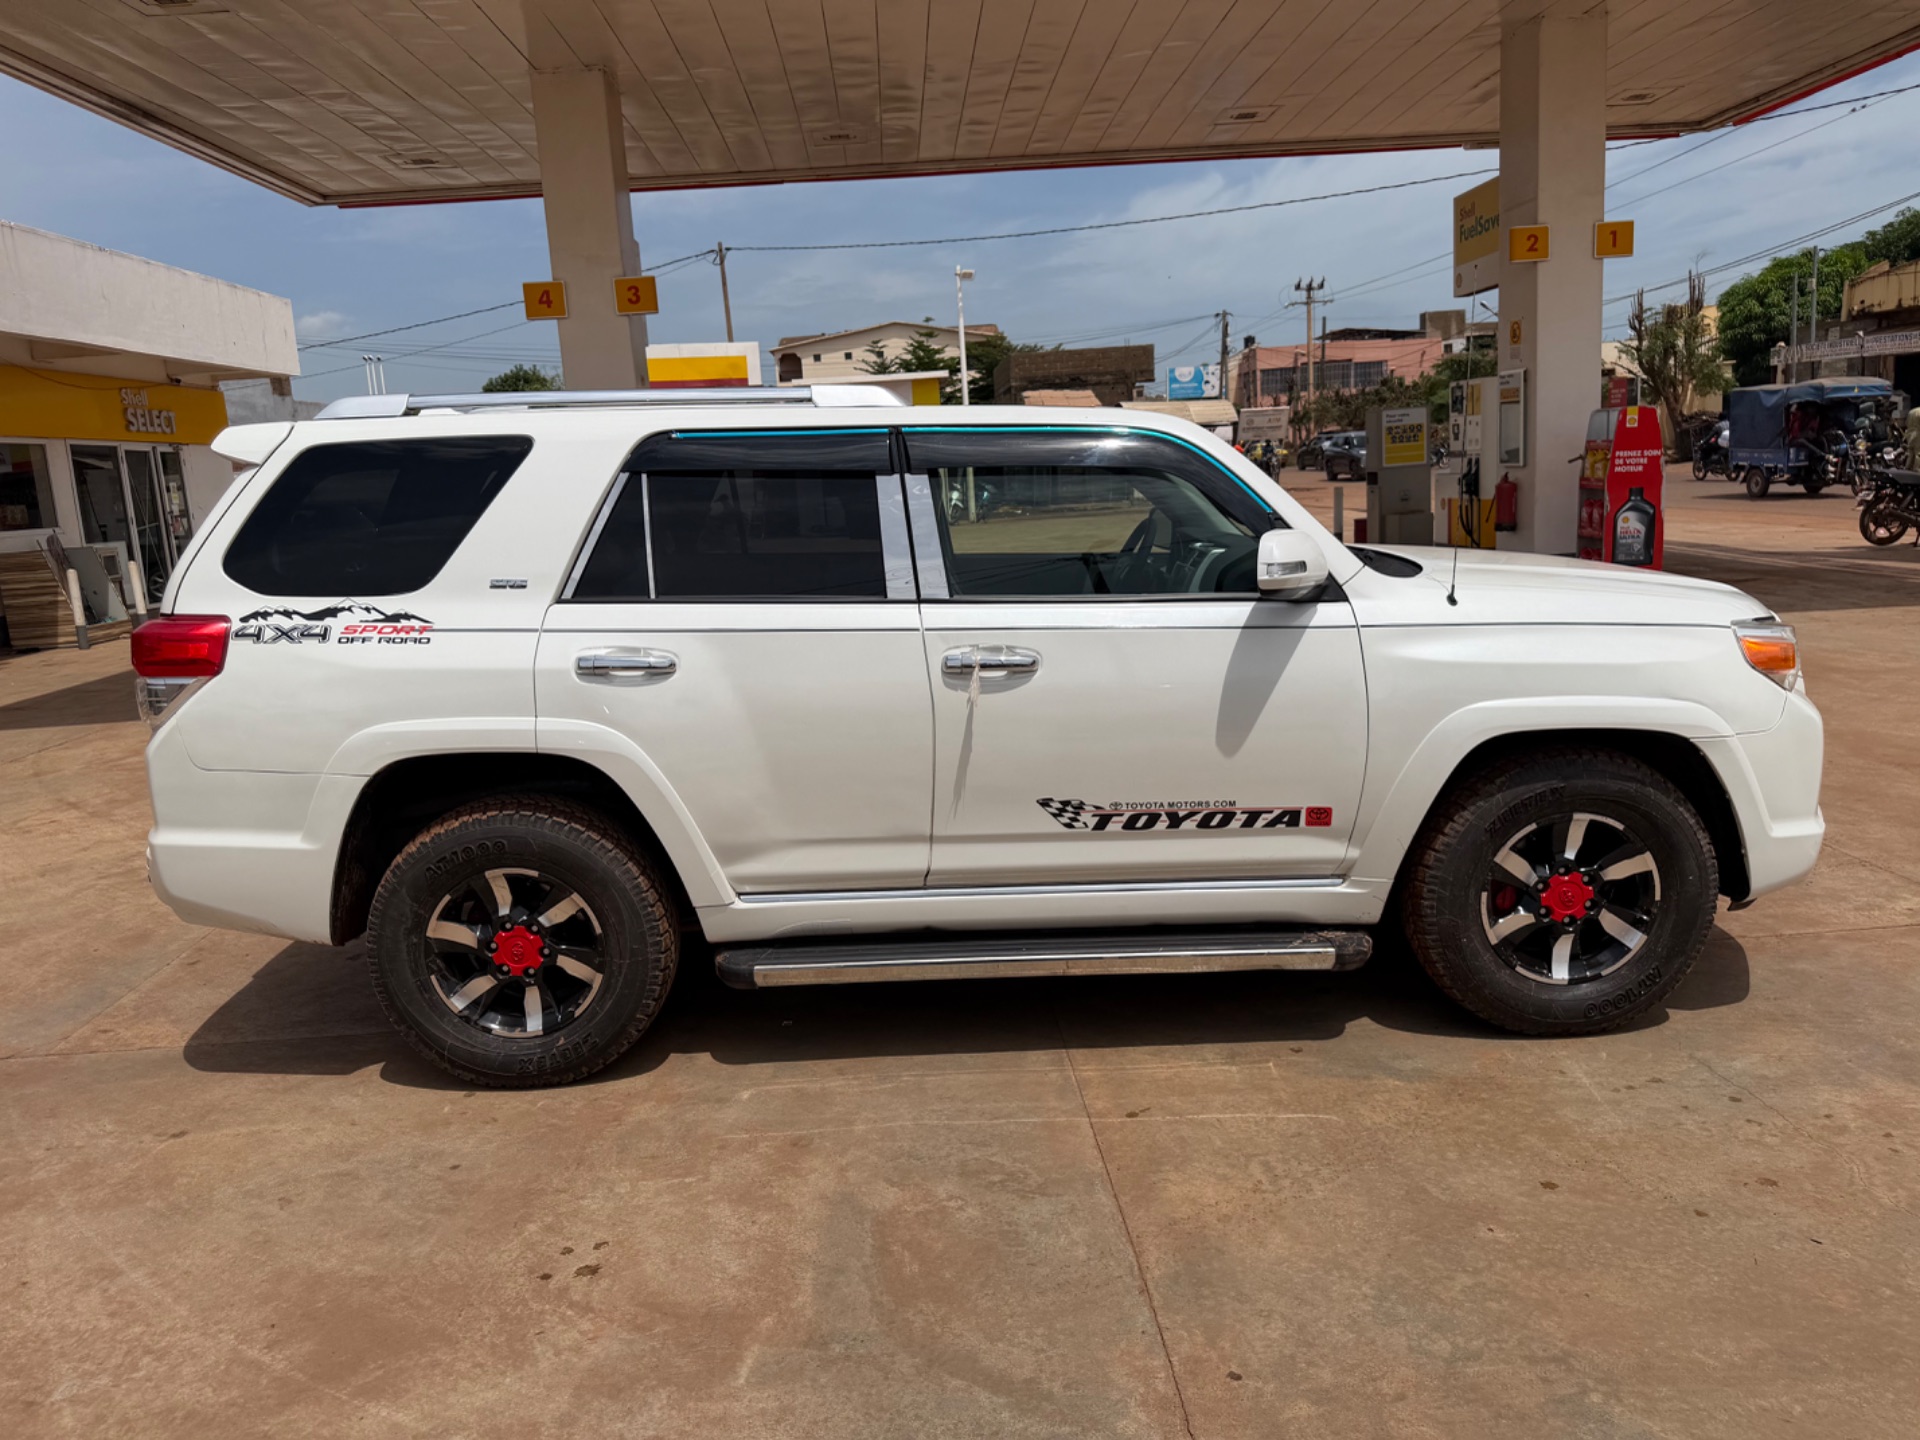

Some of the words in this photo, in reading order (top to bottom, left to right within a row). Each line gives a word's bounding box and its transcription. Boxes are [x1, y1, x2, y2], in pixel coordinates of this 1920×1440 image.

[1459, 201, 1476, 222] Shell
[1526, 234, 1539, 252] 2
[1609, 230, 1619, 249] 1
[538, 289, 553, 309] 4
[627, 286, 641, 305] 3
[120, 389, 147, 407] Shell
[125, 407, 177, 434] SELECT
[1615, 449, 1642, 457] PRENEZ
[1643, 449, 1661, 457] SOIN
[1615, 457, 1624, 465] DE
[1625, 457, 1648, 465] VOTRE
[1614, 465, 1643, 473] MOTEUR
[340, 624, 434, 635] SPORT
[337, 636, 372, 645] OFF
[377, 636, 431, 645] ROAD
[1124, 801, 1165, 809] TOYOTA
[1090, 811, 1302, 831] TOYOTA
